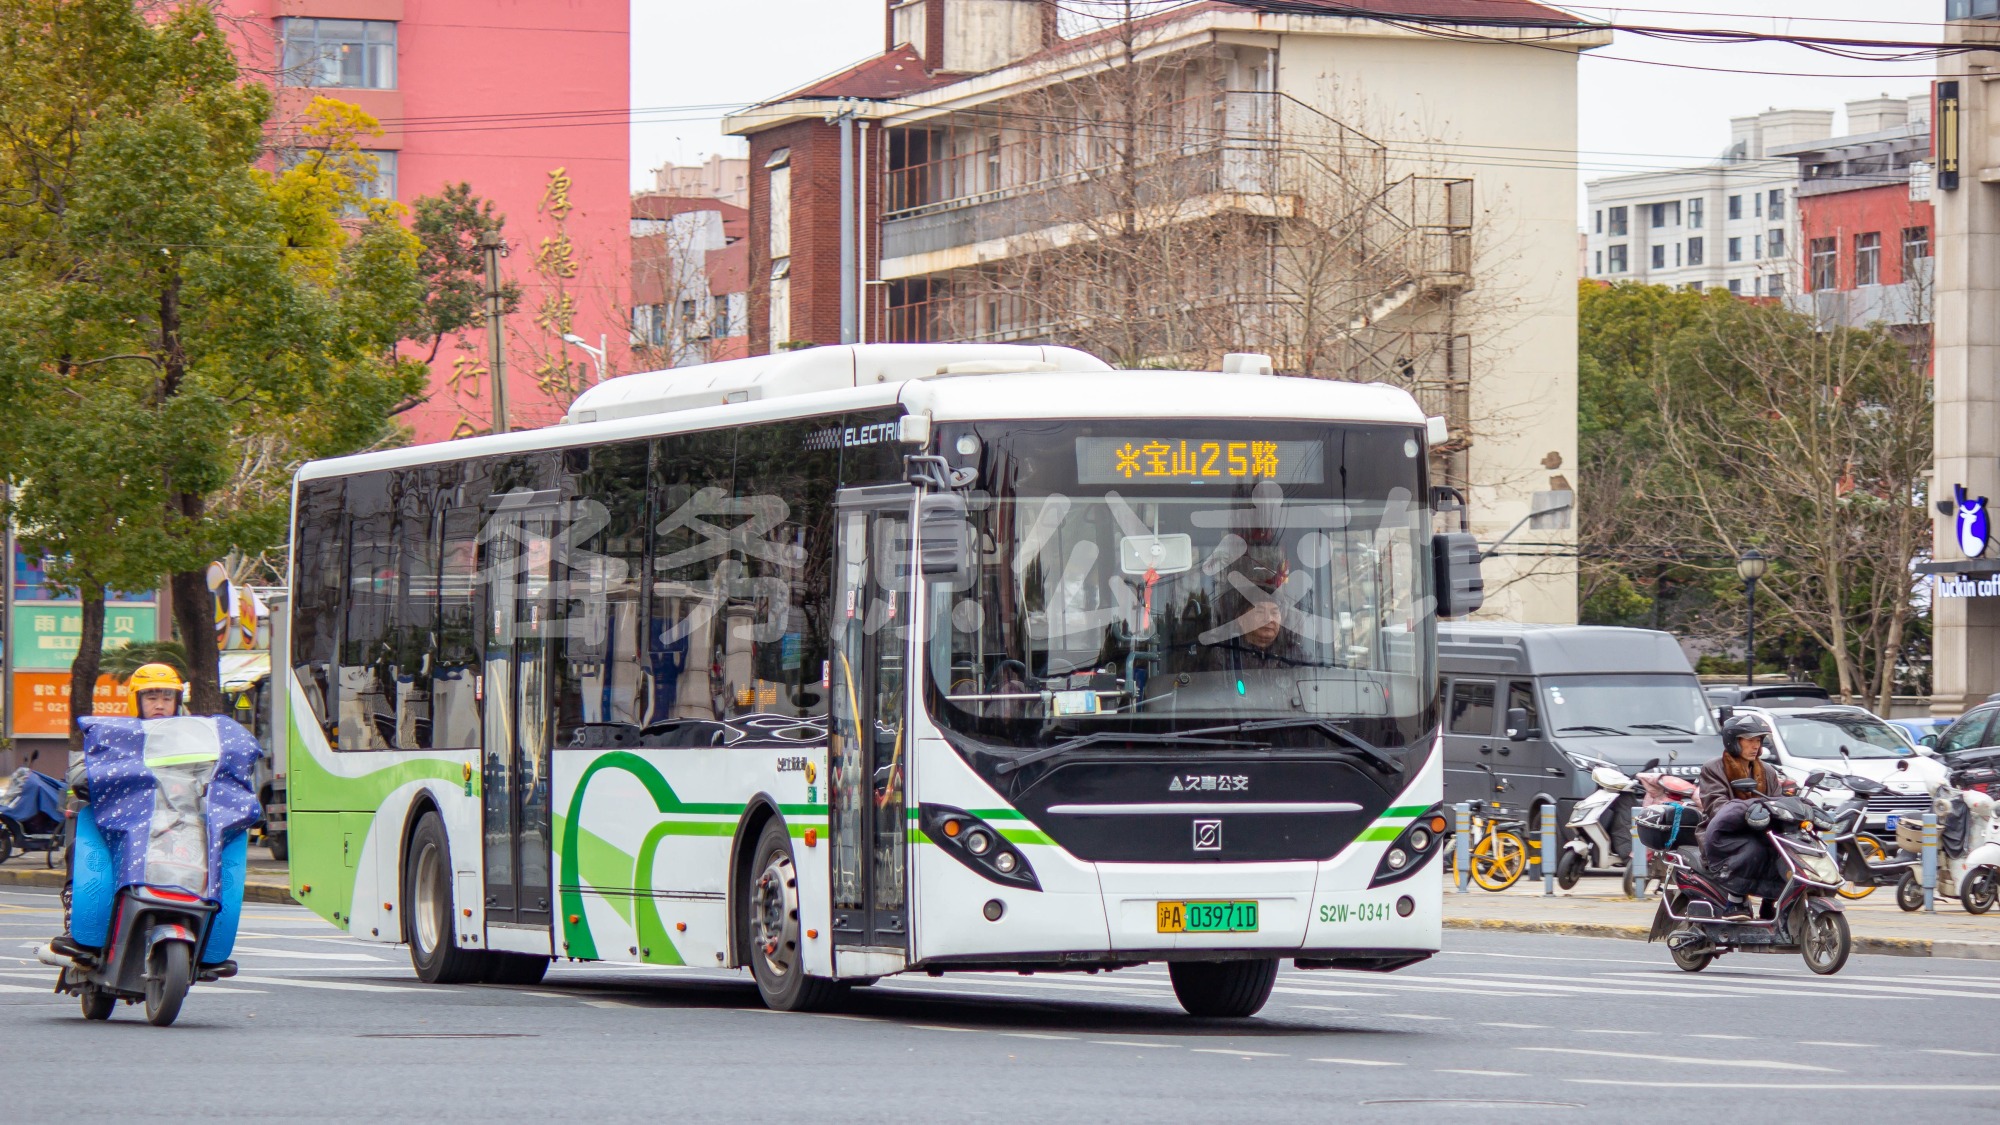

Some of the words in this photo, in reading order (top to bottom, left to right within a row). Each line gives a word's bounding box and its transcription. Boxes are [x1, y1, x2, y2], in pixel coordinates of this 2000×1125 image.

[844, 421, 901, 447] ELECTRI
[1938, 575, 1977, 598] luckin
[34, 615, 134, 634] 雨林贝
[1319, 903, 1391, 923] S2W-0341
